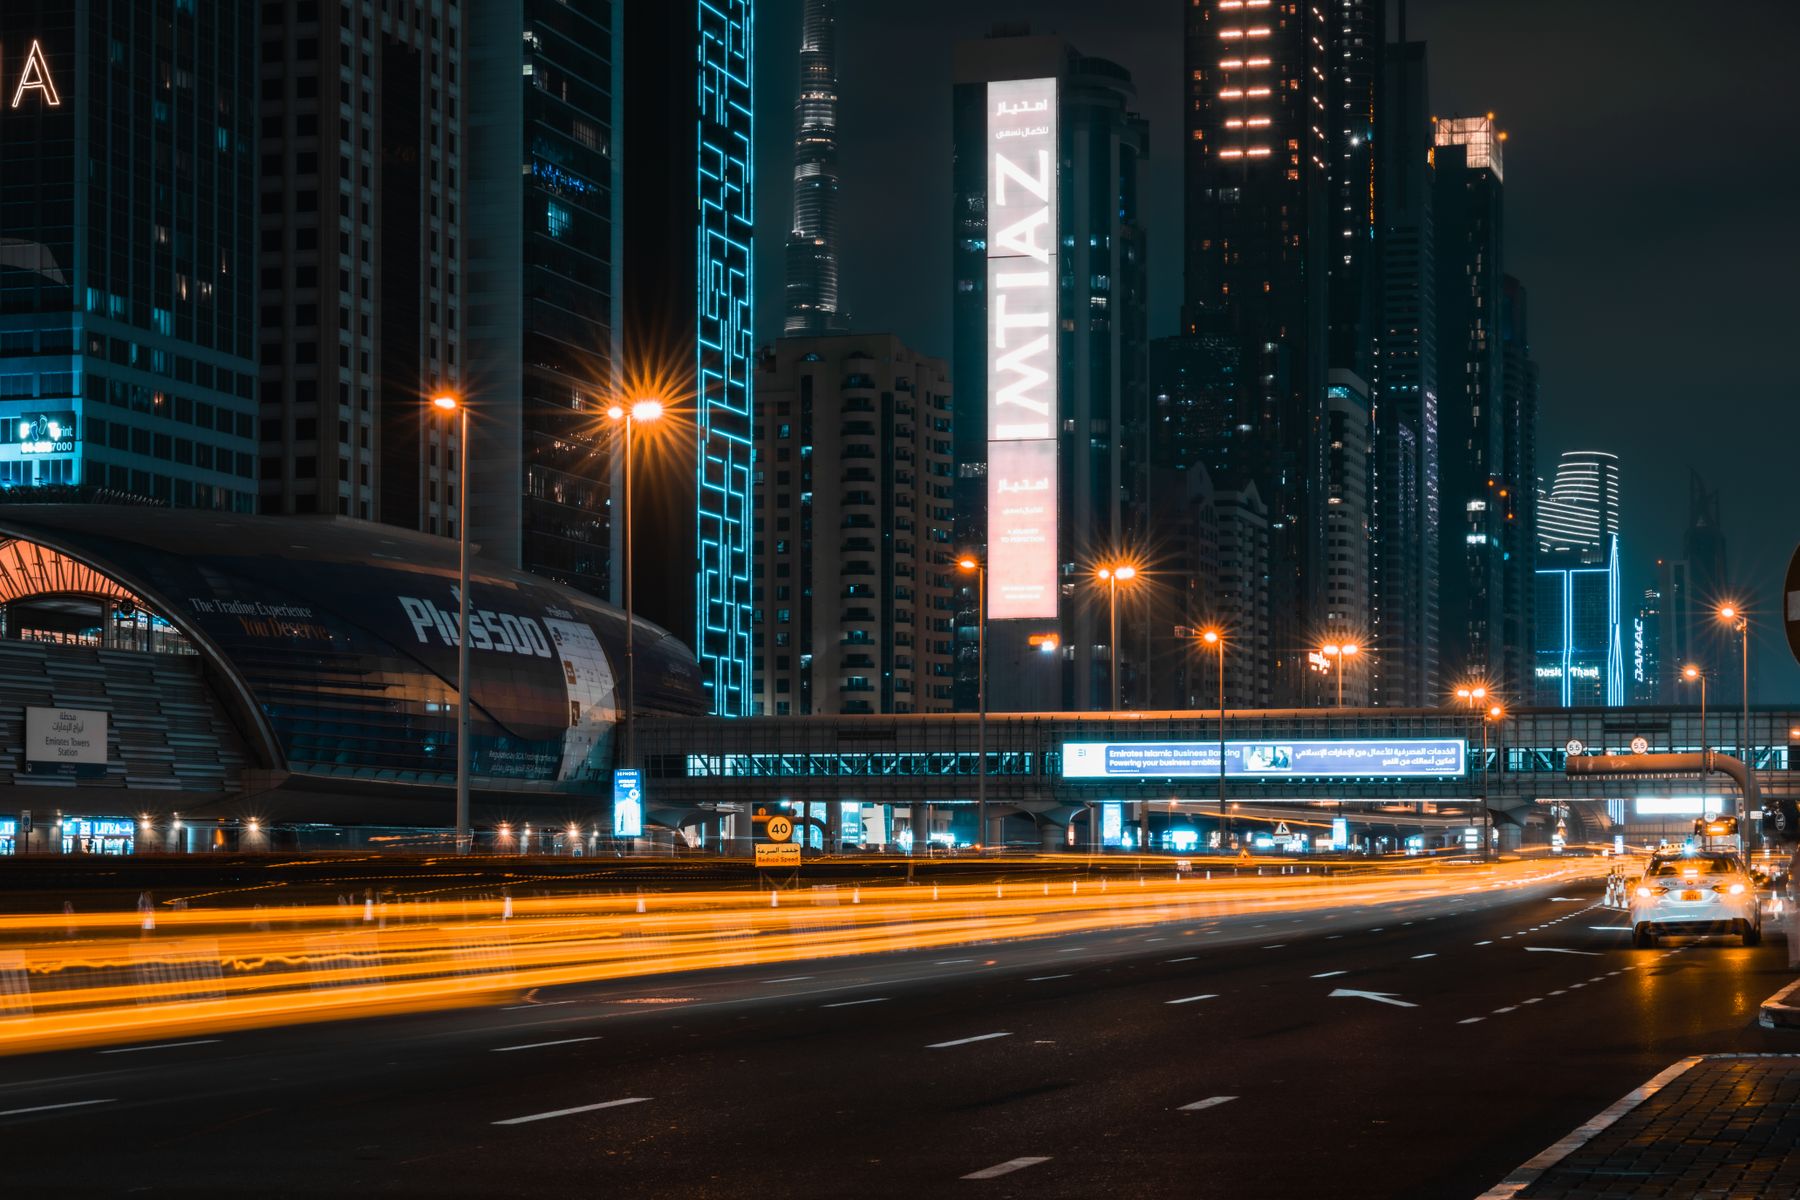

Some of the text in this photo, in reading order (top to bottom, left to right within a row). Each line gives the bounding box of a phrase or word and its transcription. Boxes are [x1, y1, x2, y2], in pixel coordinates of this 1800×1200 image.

[12, 40, 60, 108] A
[996, 149, 1050, 439] IMTIAZ
[188, 598, 313, 618] The Trading Experience
[240, 616, 329, 640] You Deserve
[397, 595, 552, 658] Plus500
[1634, 617, 1643, 683] DAMAC
[1535, 666, 1598, 678] Dusit Thani
[59, 712, 77, 721] محطة
[45, 736, 90, 748] Emirates Towers
[58, 747, 78, 757] Station
[1109, 749, 1143, 758] Emirates
[1144, 749, 1172, 758] Islamic
[1173, 749, 1208, 757] Business
[1295, 748, 1327, 760] الإسلامي
[1327, 748, 1354, 758] الإمارات
[1354, 749, 1366, 758] من
[1394, 747, 1426, 757] المصرفية
[1427, 747, 1456, 755] الخدمات
[1109, 758, 1142, 768] Powering
[1142, 760, 1159, 768] your
[1160, 758, 1191, 767] business
[771, 823, 788, 834] 40
[757, 846, 780, 855] السرعة
